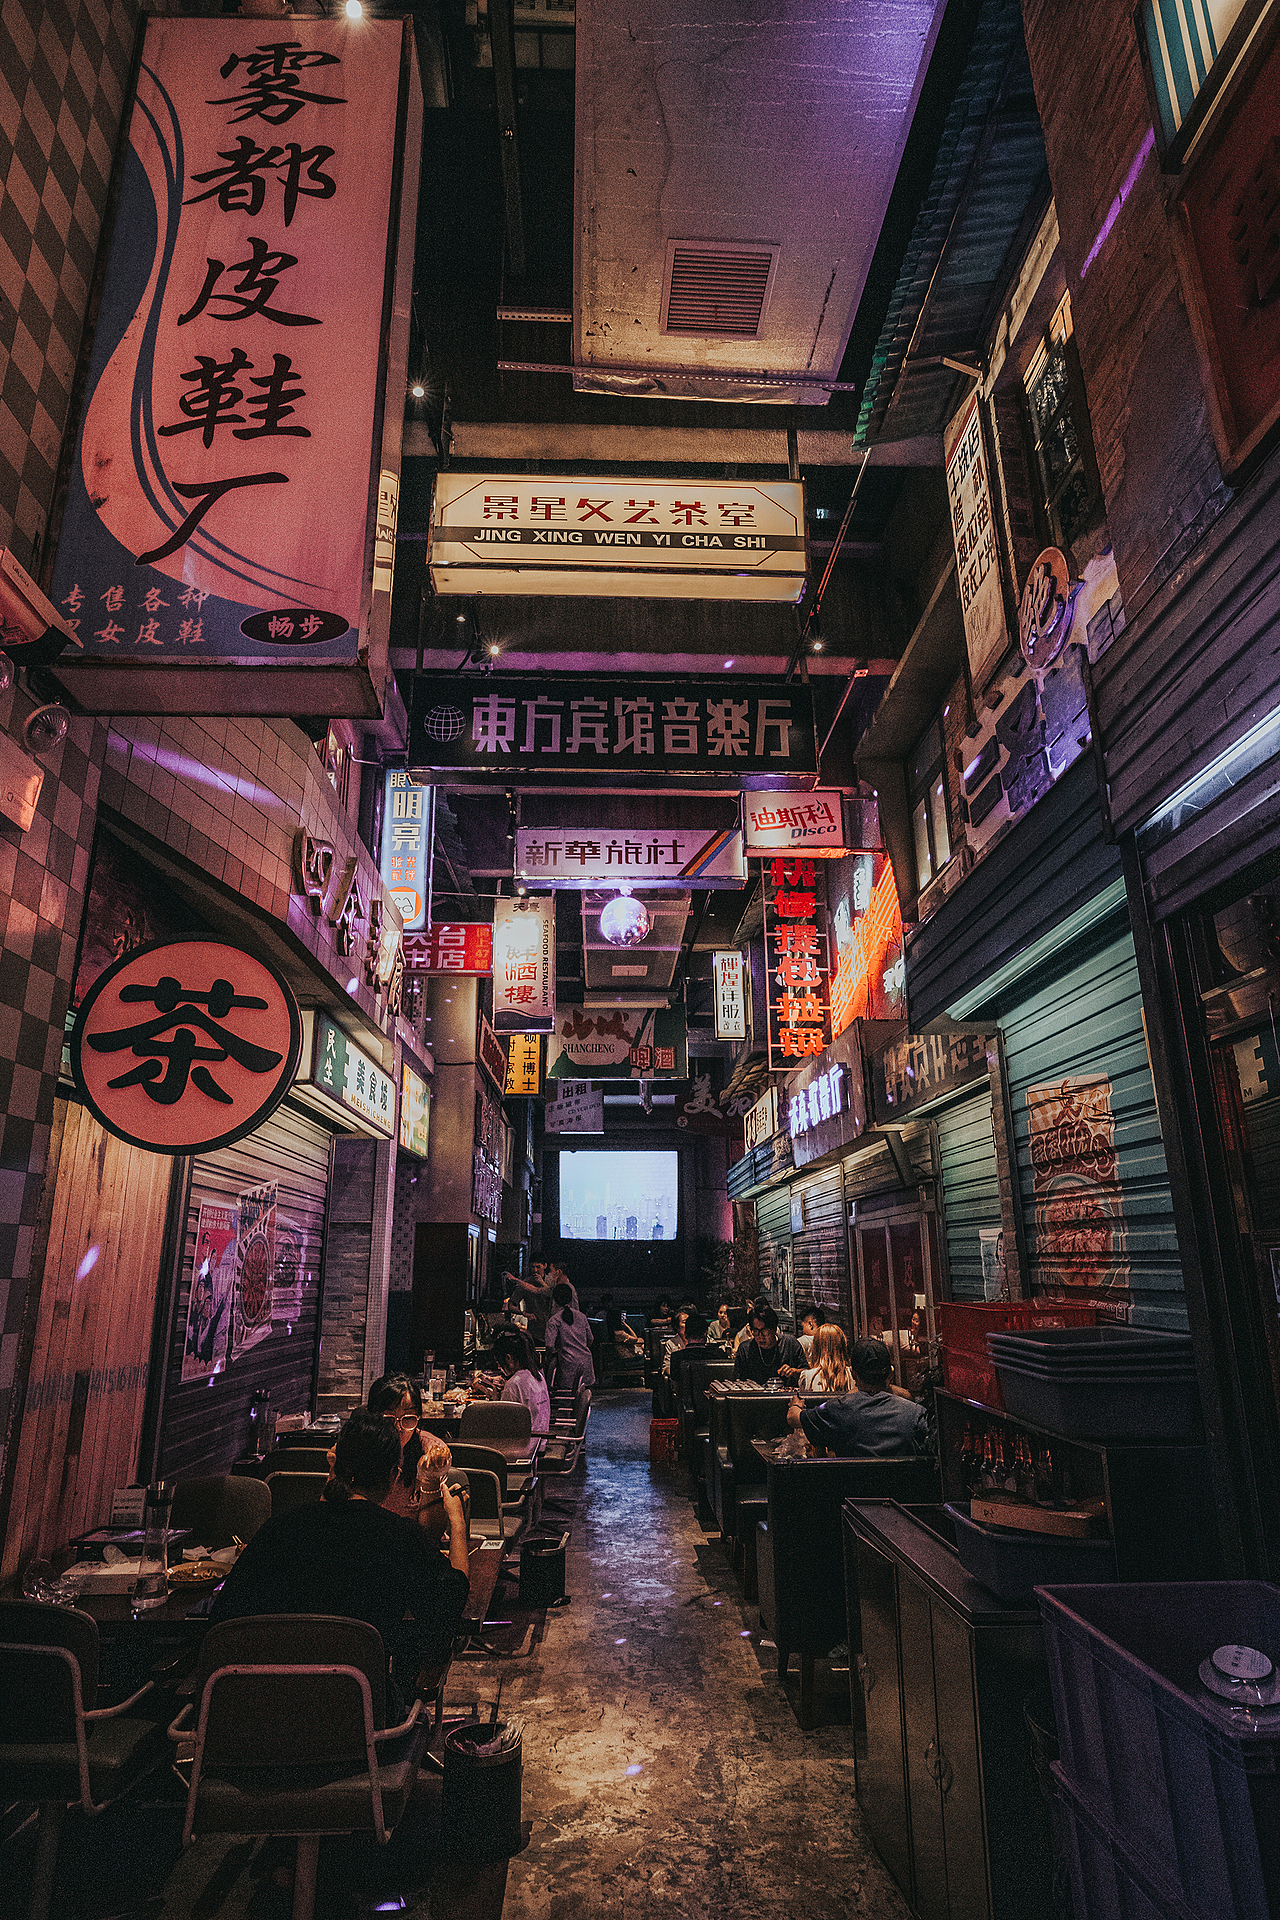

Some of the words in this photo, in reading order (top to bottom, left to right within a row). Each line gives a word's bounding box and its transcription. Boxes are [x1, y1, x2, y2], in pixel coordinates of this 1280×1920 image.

[136, 42, 347, 566] 雾都皮鞋厂
[482, 494, 757, 528] 景星文艺茶室
[473, 529, 522, 542] JING
[532, 530, 583, 543] XING
[594, 532, 642, 545] WEN
[652, 534, 671, 546] YI
[681, 535, 724, 547] CHA
[733, 537, 766, 549] SHI
[61, 584, 211, 614] 专售各种
[268, 614, 324, 640] 畅步
[391, 791, 423, 851] 明亮
[750, 800, 835, 832] 迪斯科
[790, 825, 838, 840] DISCO
[391, 856, 417, 868] 验光
[391, 869, 416, 881] 配镜
[404, 948, 465, 969] 书店
[87, 975, 284, 1105] 茶
[562, 1043, 615, 1054] SHANCHENG
[323, 1028, 337, 1087] 民生
[522, 1034, 537, 1091] 硕士博士
[629, 1045, 675, 1070] 啤酒
[355, 1058, 388, 1112] 美食城
[562, 1082, 587, 1099] 出租
[350, 1092, 392, 1130] MEISHICHENG
